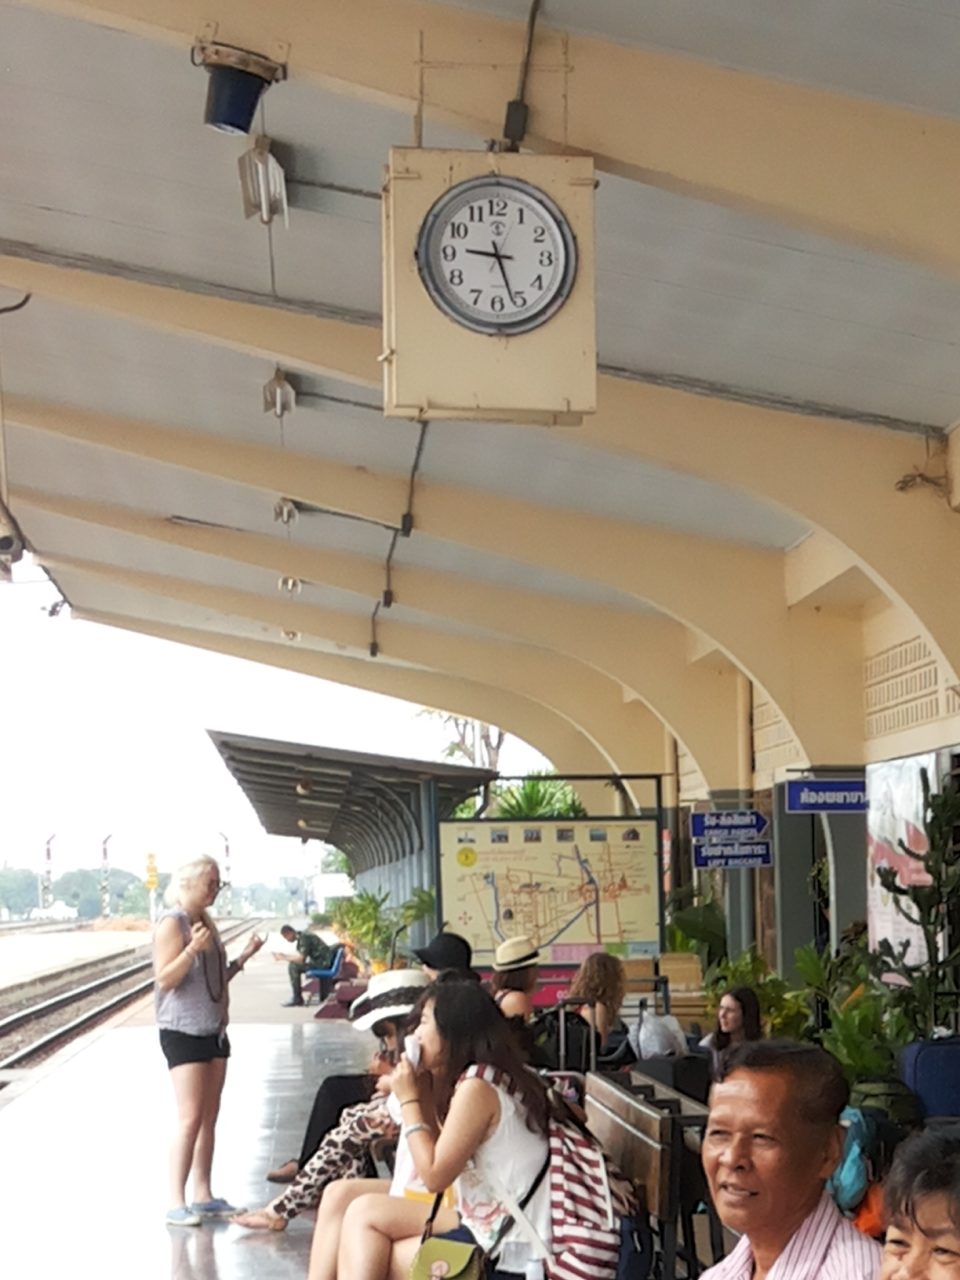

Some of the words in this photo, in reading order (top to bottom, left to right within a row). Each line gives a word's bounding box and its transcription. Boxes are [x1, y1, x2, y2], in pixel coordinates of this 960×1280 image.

[468, 205, 484, 222] 11
[488, 199, 508, 216] 12
[517, 207, 525, 225] 1
[450, 222, 469, 239] 10
[533, 226, 546, 243] 2
[442, 244, 456, 262] 9
[539, 250, 553, 267] 3
[449, 268, 464, 286] 8
[530, 274, 543, 291] 4
[469, 288, 483, 306] 7
[490, 295, 505, 312] 6
[513, 291, 527, 308] 5
[800, 787, 866, 804] ห้องพยาบา
